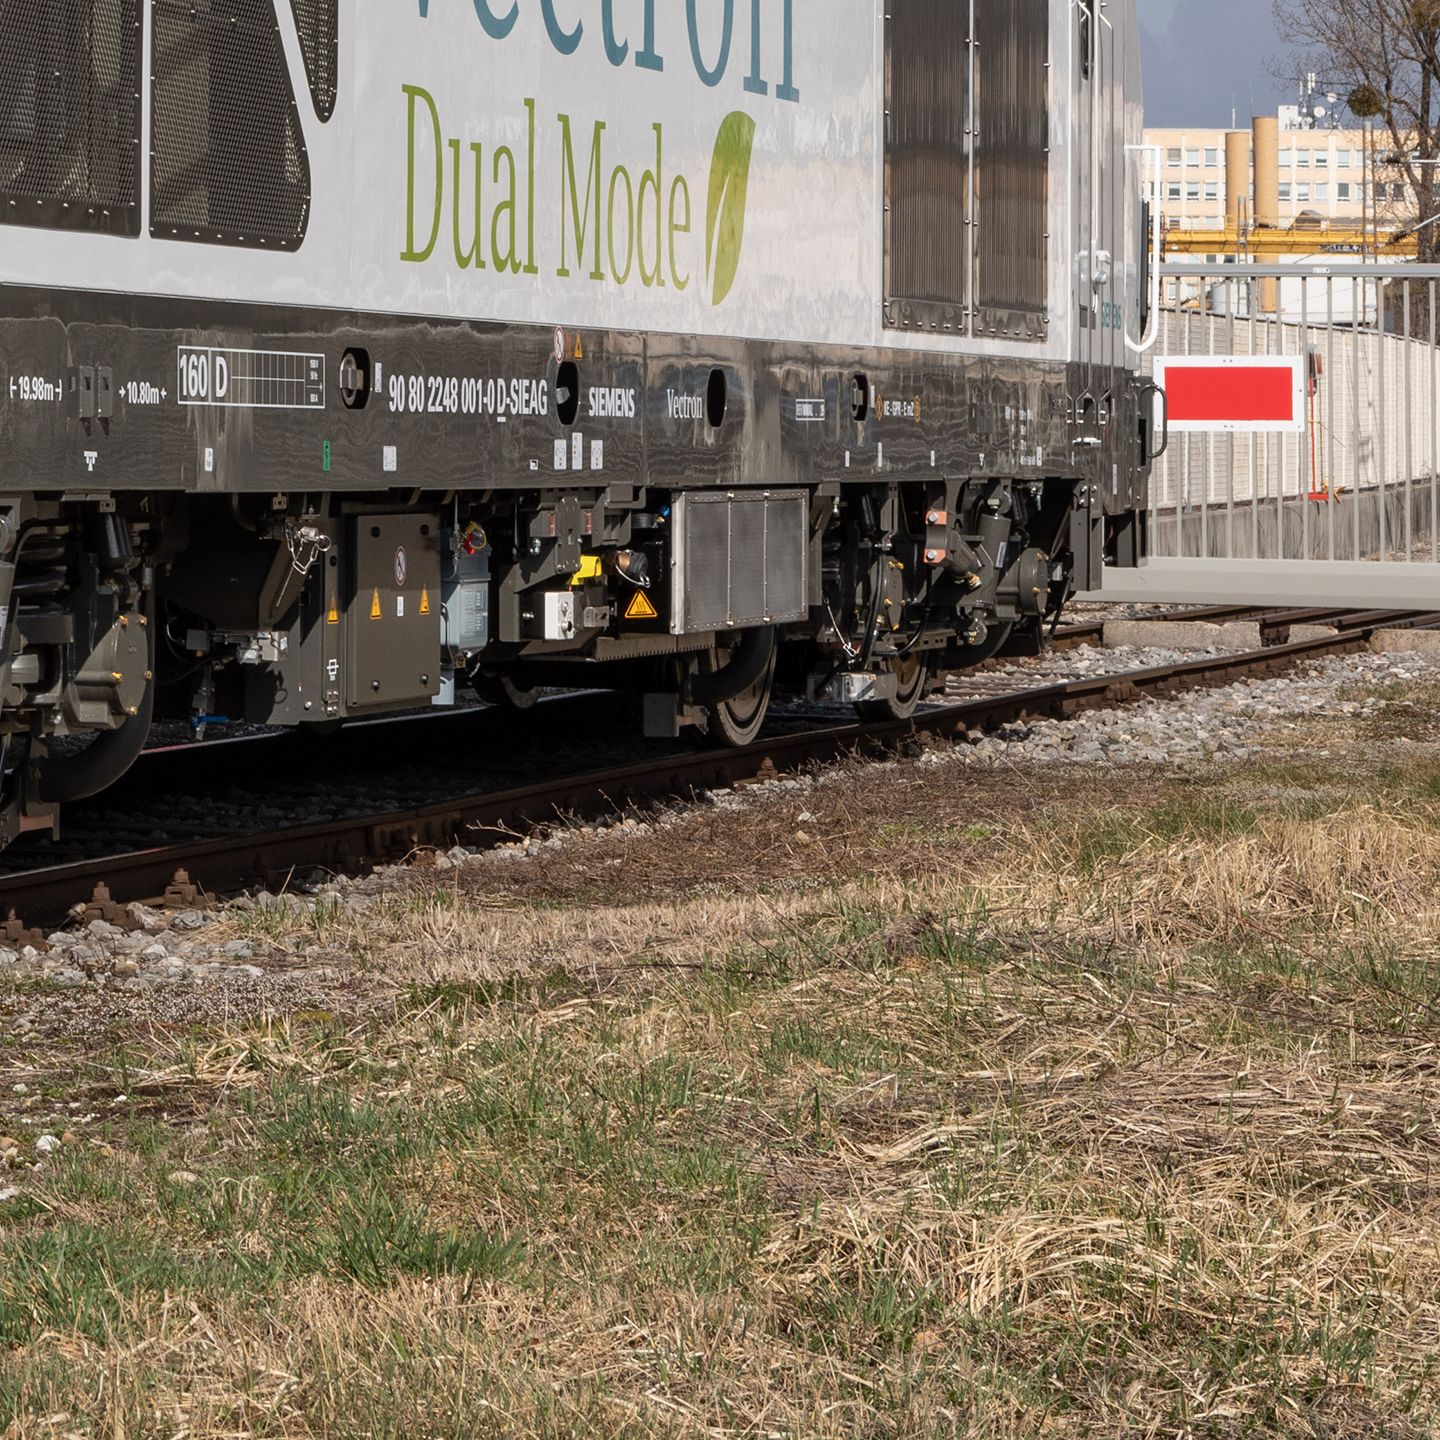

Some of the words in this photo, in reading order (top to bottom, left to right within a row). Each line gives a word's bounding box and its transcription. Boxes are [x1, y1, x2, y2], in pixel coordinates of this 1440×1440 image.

[399, 83, 538, 275] Dual
[556, 113, 691, 291] Mode
[19, 376, 54, 401] 19.98m
[180, 354, 208, 397] 160
[215, 356, 228, 397] D
[126, 381, 160, 404] 10.80m
[389, 375, 405, 412] 90
[408, 376, 425, 413] 80
[427, 376, 458, 413] 2248
[461, 377, 495, 414] 001-0
[497, 378, 548, 415] D-SIEAG
[588, 386, 635, 418] SIEMENS
[667, 388, 703, 419] Vectron
